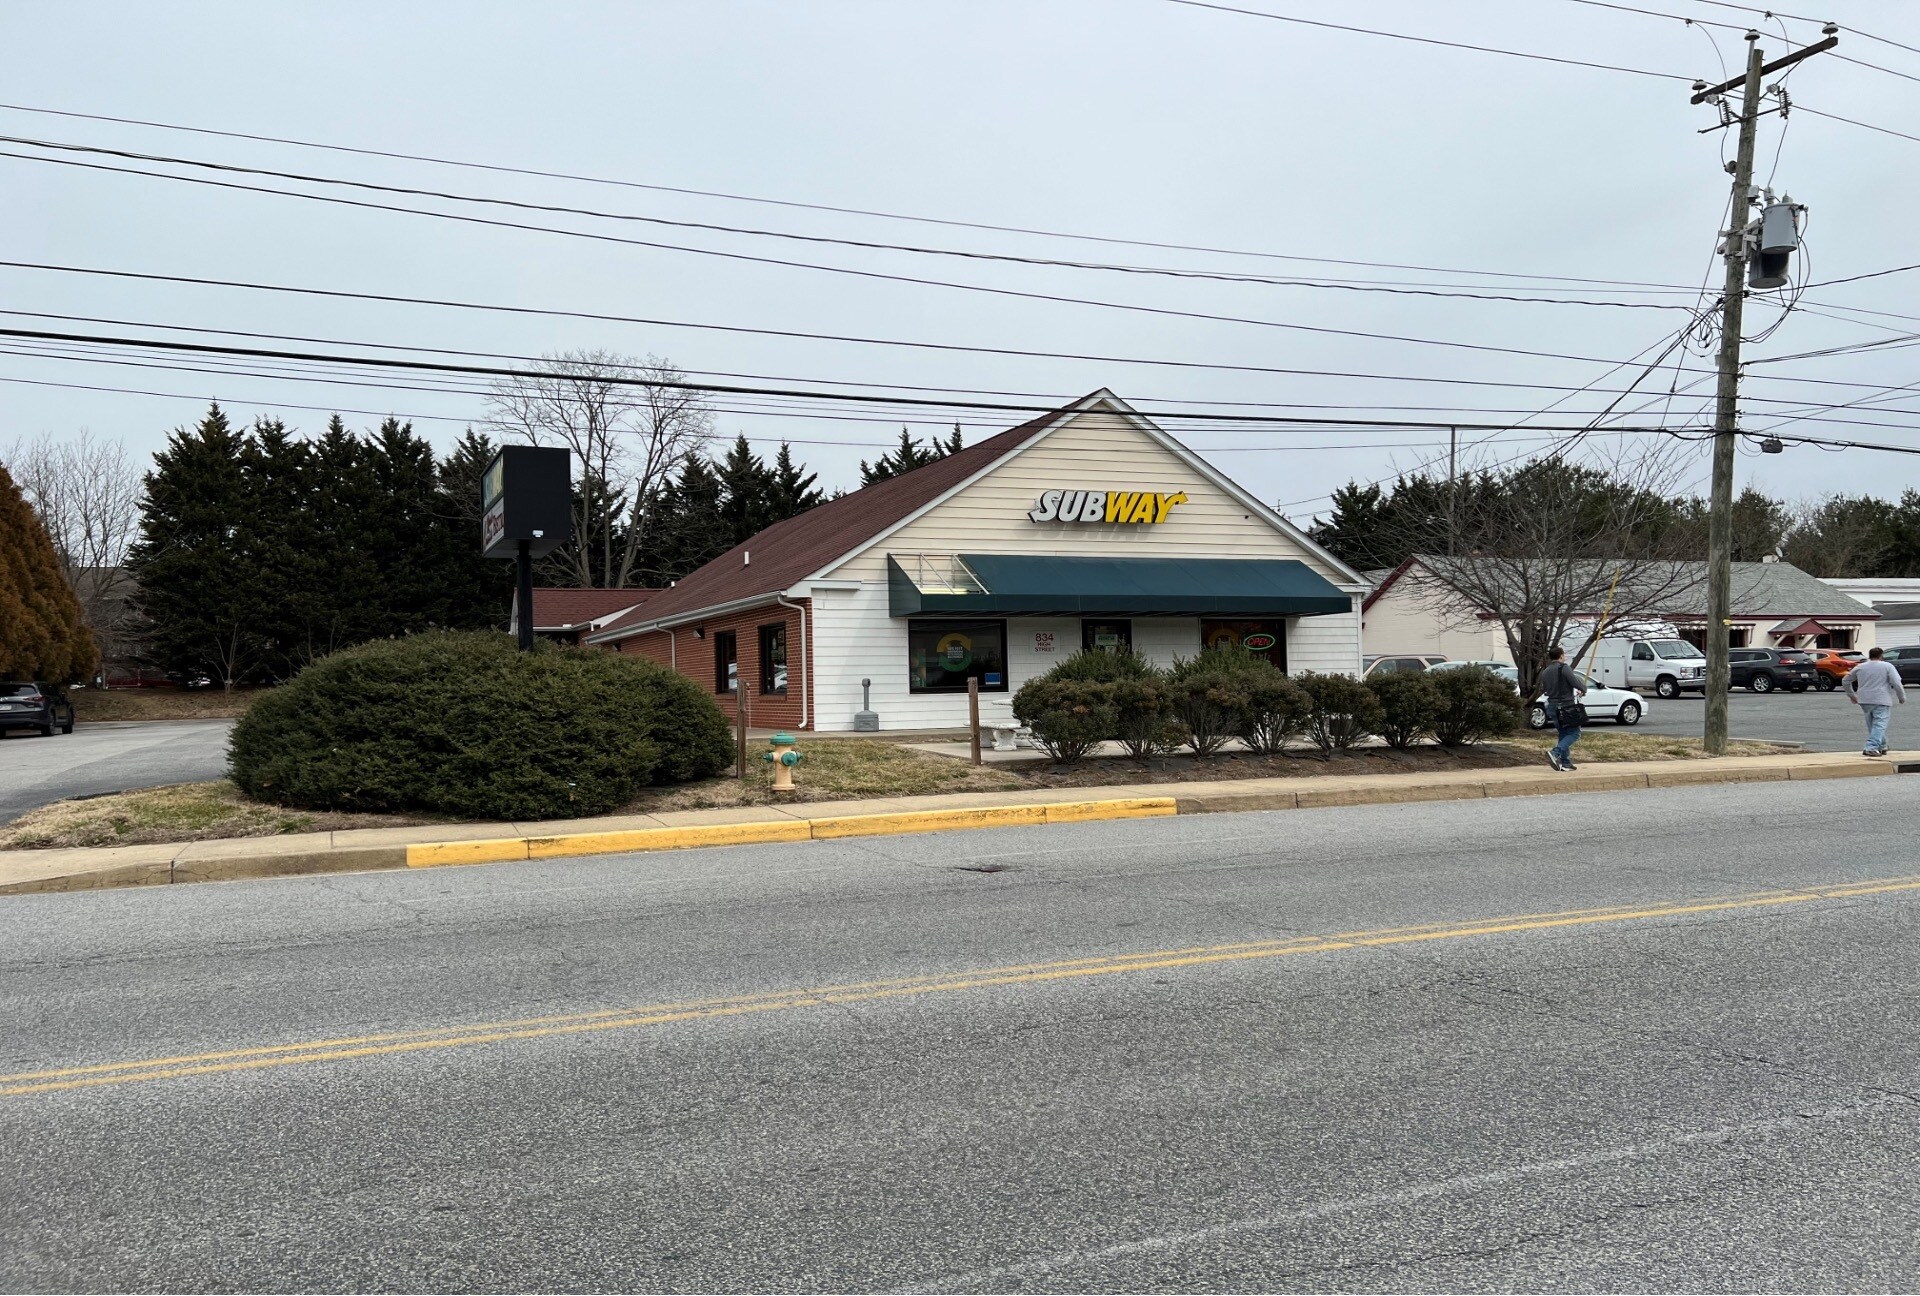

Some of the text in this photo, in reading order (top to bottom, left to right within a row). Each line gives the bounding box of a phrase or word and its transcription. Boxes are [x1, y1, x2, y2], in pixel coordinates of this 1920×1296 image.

[1027, 489, 1188, 524] SUBWAY
[1035, 633, 1054, 642] 834
[1247, 637, 1271, 646] OPEN
